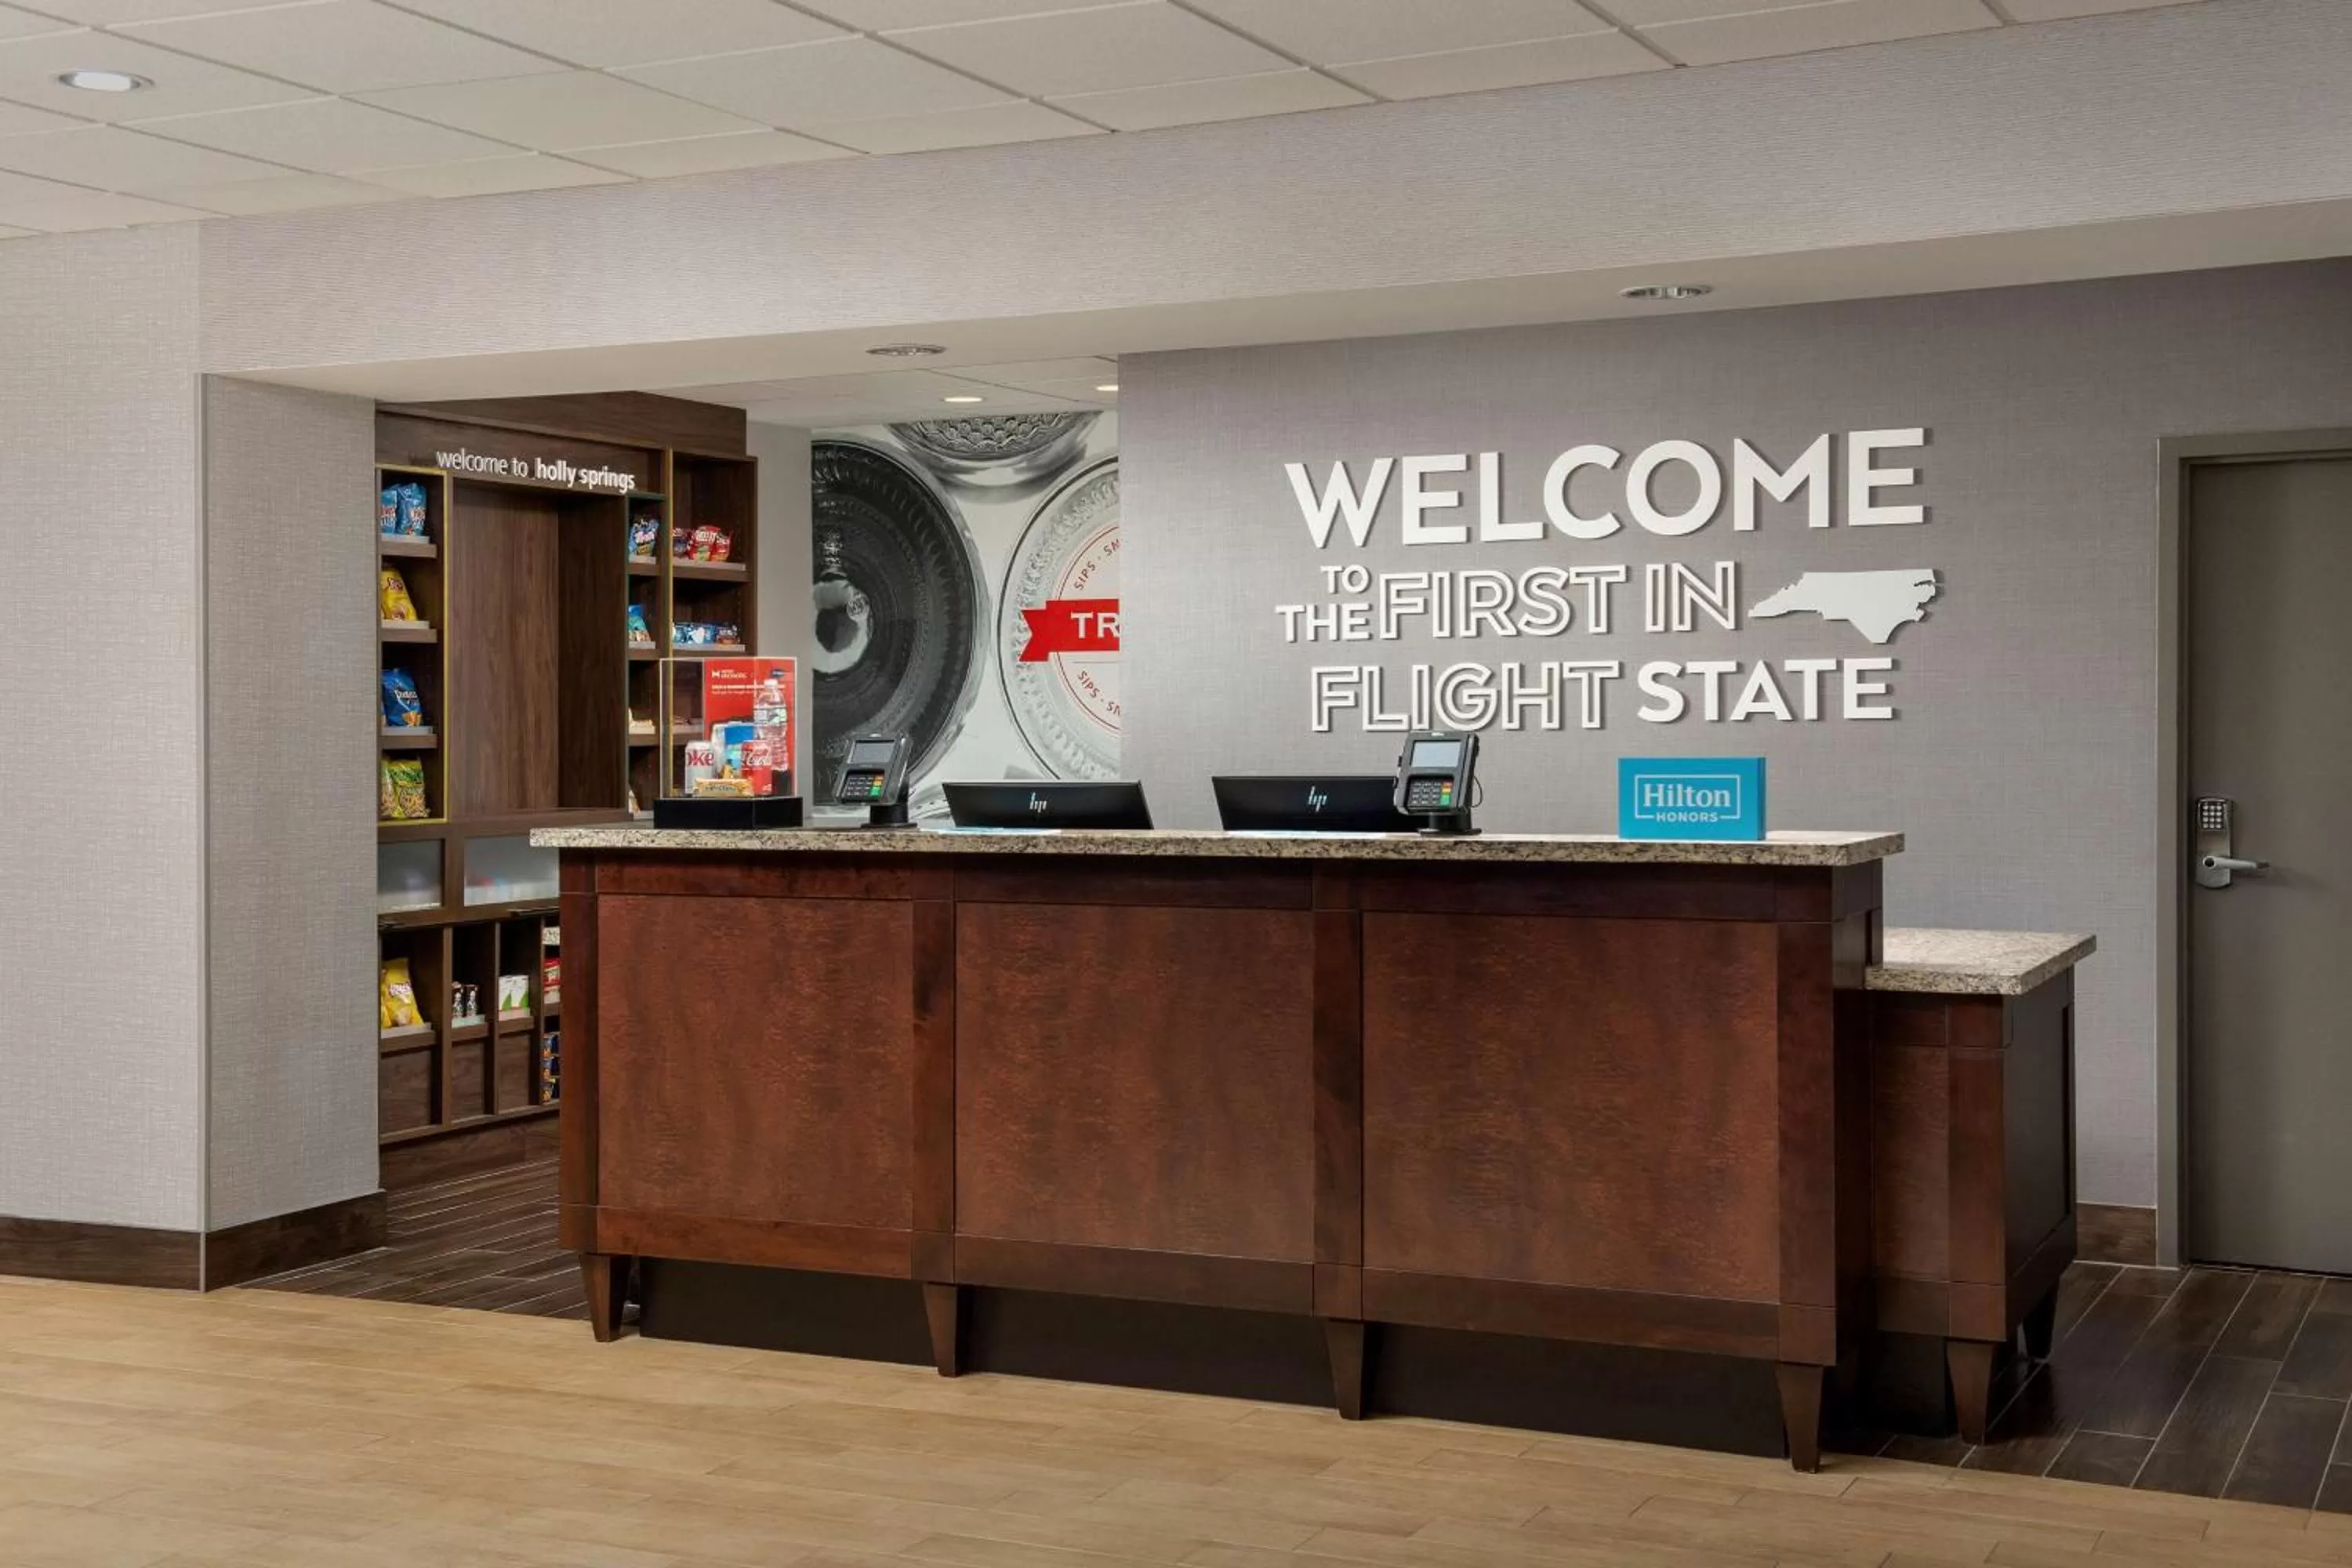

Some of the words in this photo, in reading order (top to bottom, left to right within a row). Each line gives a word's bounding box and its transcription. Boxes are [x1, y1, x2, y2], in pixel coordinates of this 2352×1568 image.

[436, 448, 508, 475] welcome
[512, 457, 528, 477] to
[535, 457, 576, 488] holly
[579, 466, 635, 493] springs
[1285, 429, 1923, 549] WELCOME
[1073, 561, 1096, 590] SIPS
[1319, 564, 1369, 594] TO
[1275, 602, 1370, 642] THE
[1379, 564, 1626, 638] FIRST
[1646, 561, 1737, 633] IN
[1077, 670, 1100, 699] SIPS
[1310, 660, 1621, 731] FLIGHT
[1638, 657, 1893, 722] STATE
[1643, 783, 1731, 808] Hilton
[1656, 811, 1719, 822] HONORS
